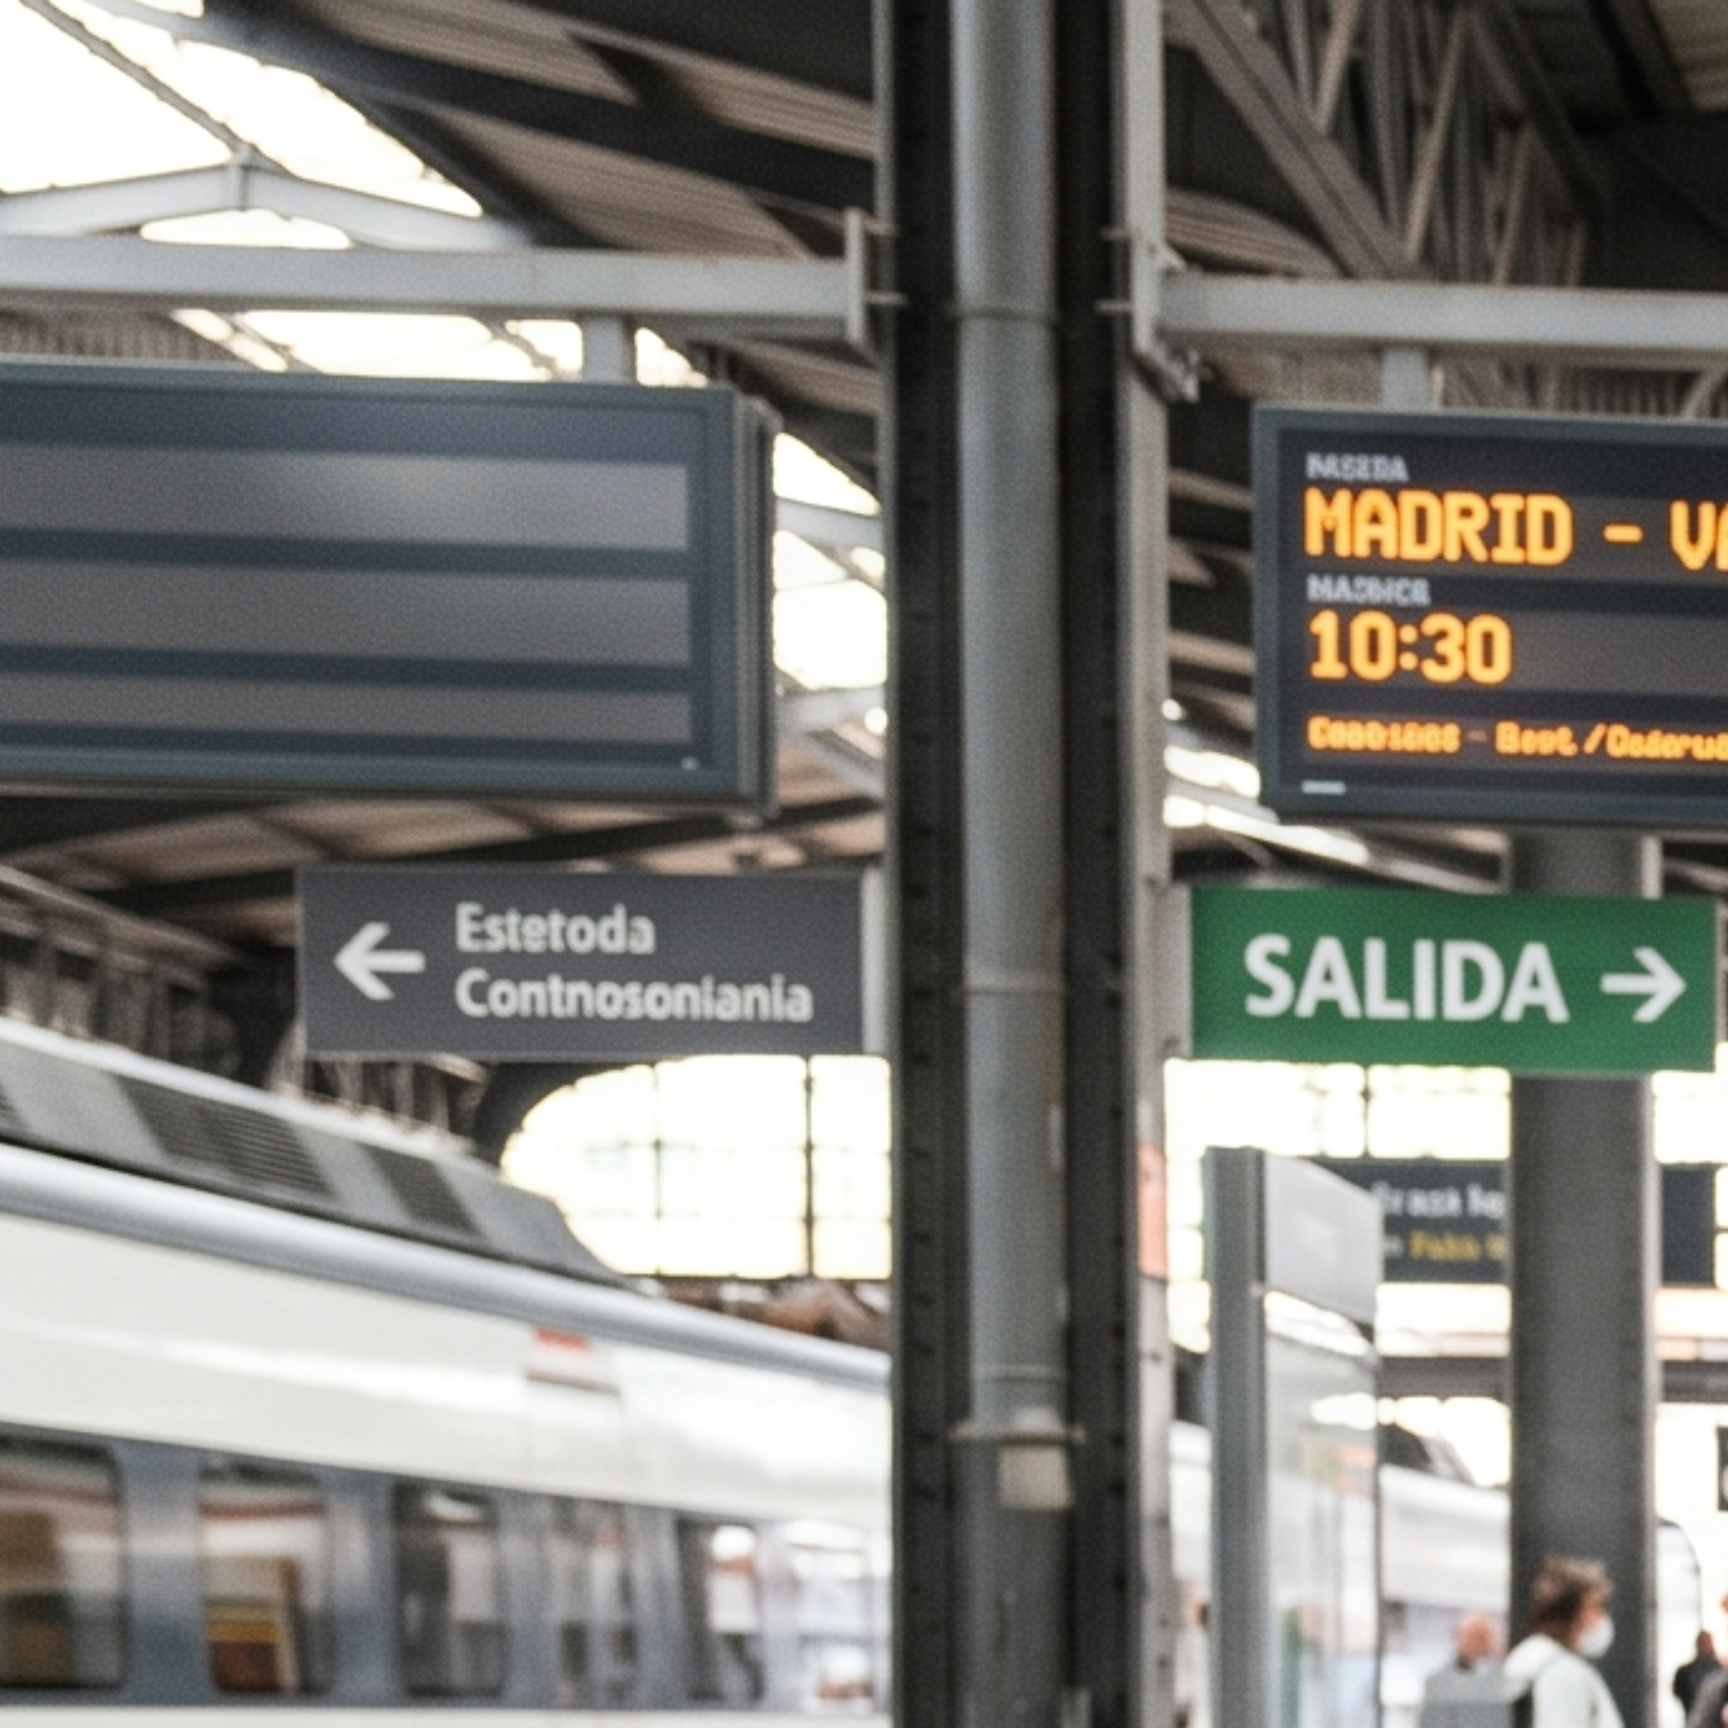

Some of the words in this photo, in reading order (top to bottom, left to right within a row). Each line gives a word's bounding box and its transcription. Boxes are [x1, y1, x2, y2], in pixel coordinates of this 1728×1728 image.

[1305, 487, 1573, 565] MADRID
[1603, 523, 1644, 543] -
[1310, 609, 1512, 685] 10:30
[1245, 934, 1568, 1023] SALIDA
